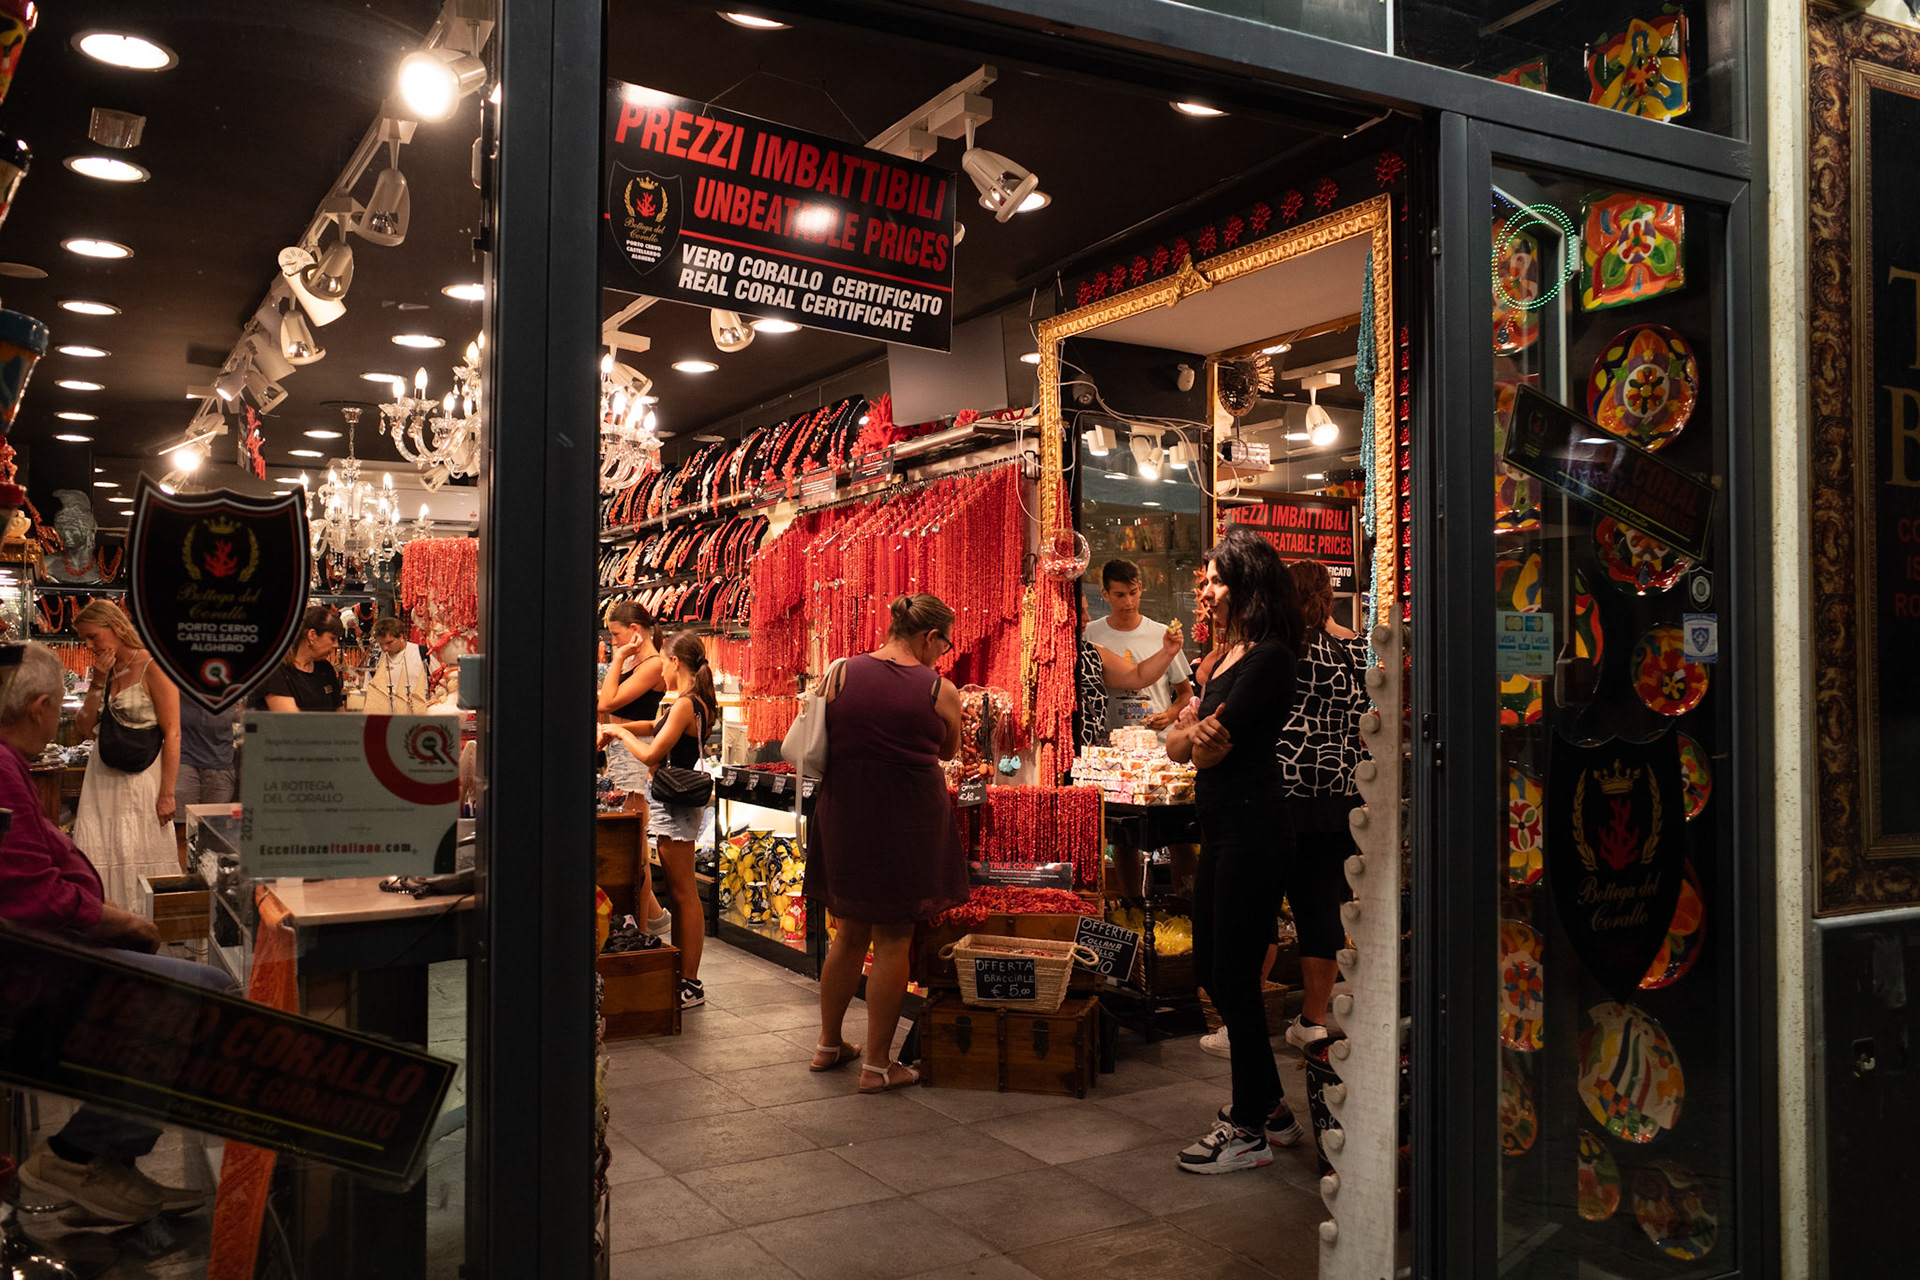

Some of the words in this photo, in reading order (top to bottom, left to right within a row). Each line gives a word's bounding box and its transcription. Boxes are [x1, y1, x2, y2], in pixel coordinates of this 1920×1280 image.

[615, 100, 745, 171] PREZZI
[750, 132, 947, 221] IMBATTIBILI
[864, 218, 949, 272] PRICES
[681, 243, 733, 274] VERO
[738, 255, 824, 291] CORALLO
[832, 277, 943, 316] CERTIFICATO
[678, 268, 729, 296] REAL
[734, 279, 797, 310] CORAL
[801, 294, 915, 332] CERTIFICATE
[1272, 505, 1350, 531] IMBATTIBILI
[1254, 531, 1316, 553] BEATABLE
[1317, 535, 1352, 556] PRICES
[1328, 566, 1352, 577] FICATO
[177, 622, 218, 632] PORTO
[219, 623, 260, 633] CERVO
[177, 631, 260, 644] CASTELSARDO
[190, 642, 246, 653] ALGHERO
[263, 781, 278, 791] LA
[281, 781, 335, 791] BOTTEGA
[263, 793, 282, 804] DEL
[287, 792, 344, 804] CORALLO
[240, 807, 254, 841] 2022
[990, 862, 1011, 870] TRUE
[1577, 875, 1636, 909] Bottega
[1638, 872, 1662, 898] del
[1591, 904, 1650, 931] Corallo
[976, 959, 1034, 972] OFFERTA
[221, 1016, 427, 1104] CORALLO
